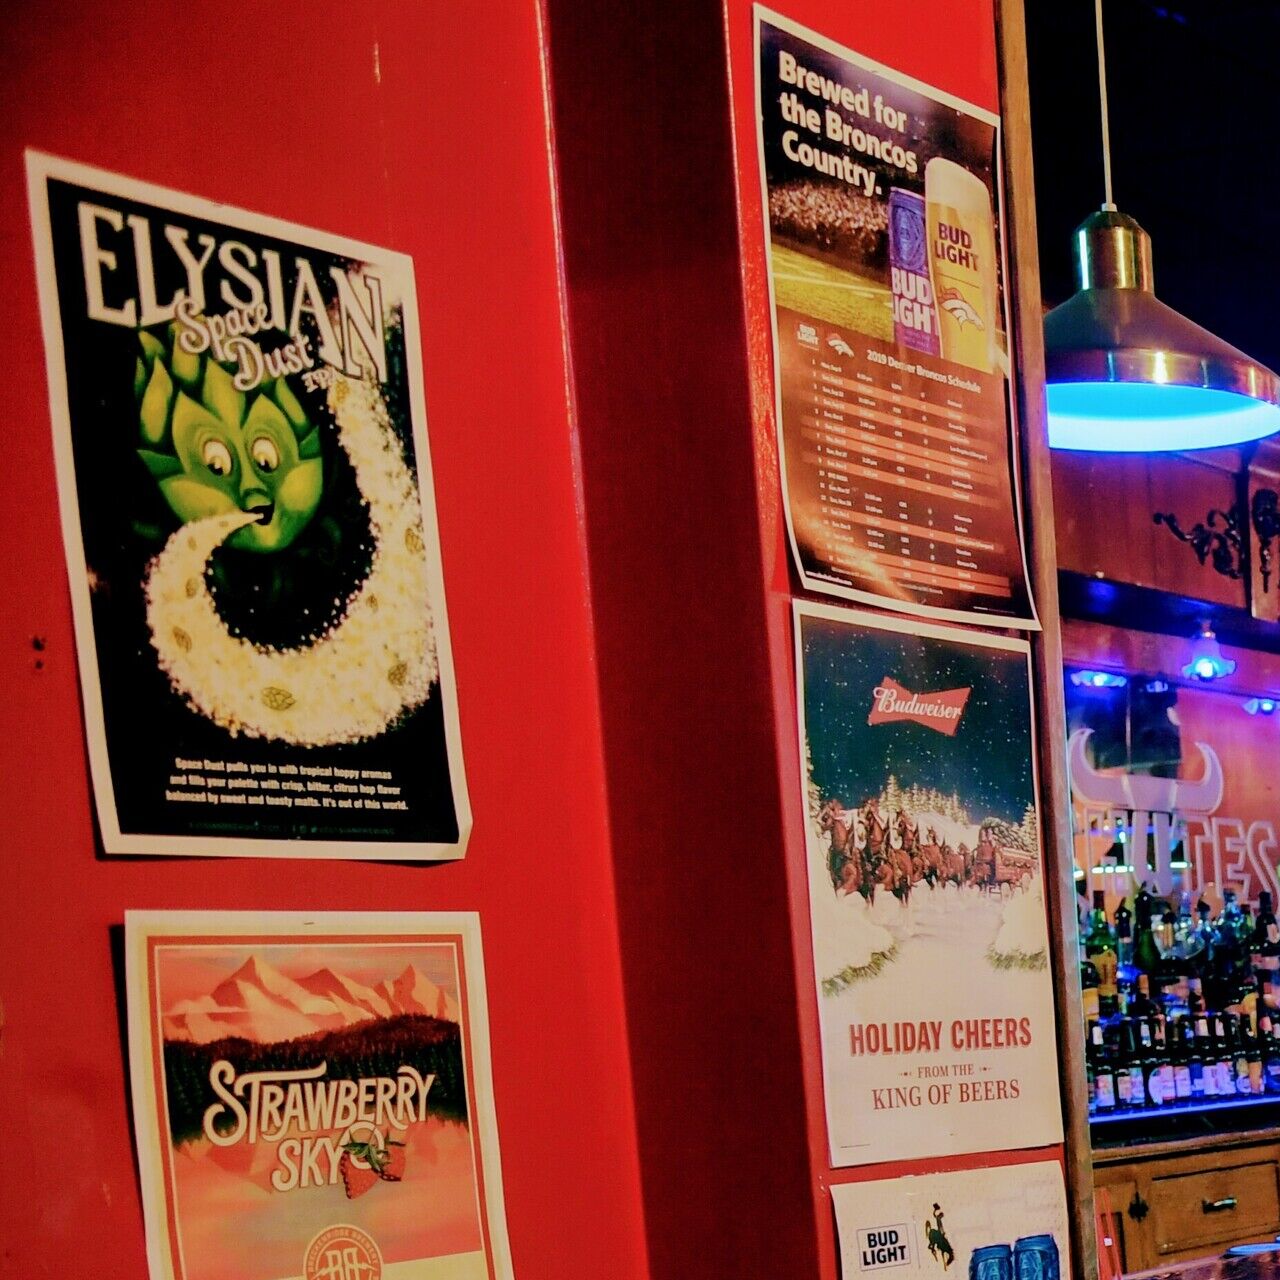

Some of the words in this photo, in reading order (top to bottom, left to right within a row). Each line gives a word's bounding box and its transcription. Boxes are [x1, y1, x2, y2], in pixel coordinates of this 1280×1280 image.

[778, 50, 871, 120] Brewed
[873, 94, 908, 135] for
[779, 91, 822, 135] the
[825, 107, 919, 174] Broncos
[781, 129, 883, 198] Country.
[933, 240, 980, 272] LIGHT
[937, 222, 973, 250] BUD
[77, 201, 388, 384] ELYSIAN
[891, 266, 933, 306] BUD
[173, 298, 274, 362] Space
[892, 293, 939, 337] IGH
[232, 332, 316, 392] Dust
[866, 349, 887, 365] 2019
[916, 364, 948, 385] Broncos
[947, 374, 982, 394] Schedule
[873, 686, 962, 720] Budweiser
[849, 1020, 943, 1057] HOLIDAY
[950, 1016, 1032, 1050] CHEERS
[917, 1065, 949, 1079] FROM
[952, 1063, 974, 1077] THE
[202, 1059, 436, 1148] STRAWBERRY
[872, 1085, 922, 1111] KING
[928, 1083, 953, 1106] OF
[959, 1079, 1021, 1103] BEERS
[270, 1123, 370, 1193] SKY
[862, 1245, 907, 1266] LIGHT
[867, 1230, 899, 1249] BUD
